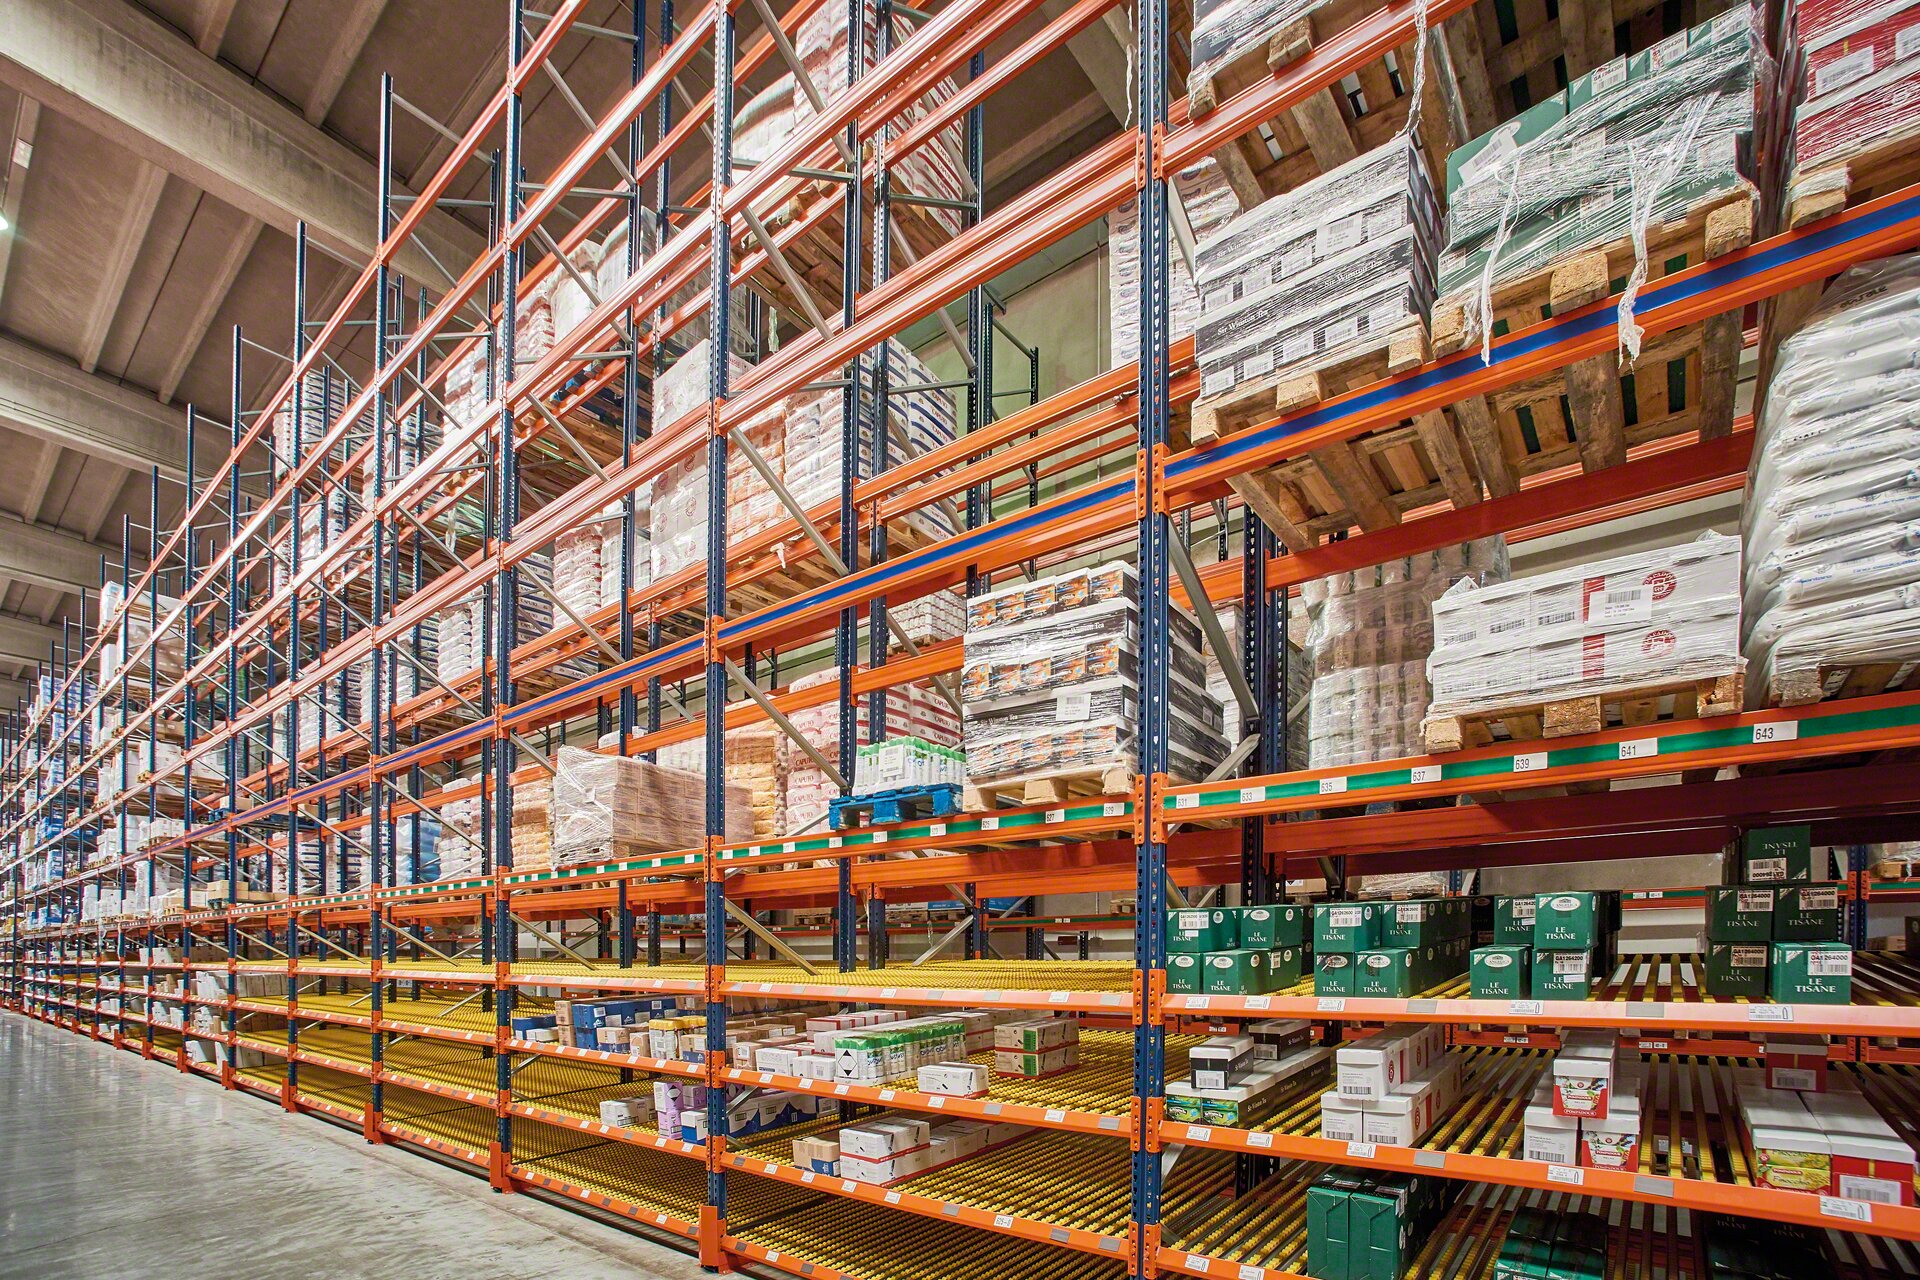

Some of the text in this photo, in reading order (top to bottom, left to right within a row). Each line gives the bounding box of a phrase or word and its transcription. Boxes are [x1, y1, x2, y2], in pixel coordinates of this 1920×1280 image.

[1756, 727, 1774, 740] 643
[1620, 744, 1637, 757] 641
[1515, 758, 1530, 770] 639
[795, 775, 814, 784] CAPUTO
[1412, 770, 1426, 782] 637
[1321, 782, 1333, 792] 635
[1242, 792, 1252, 802] 633
[1178, 798, 1188, 808] 631
[1046, 814, 1055, 822] 627
[1795, 985, 1836, 993] TISANE
